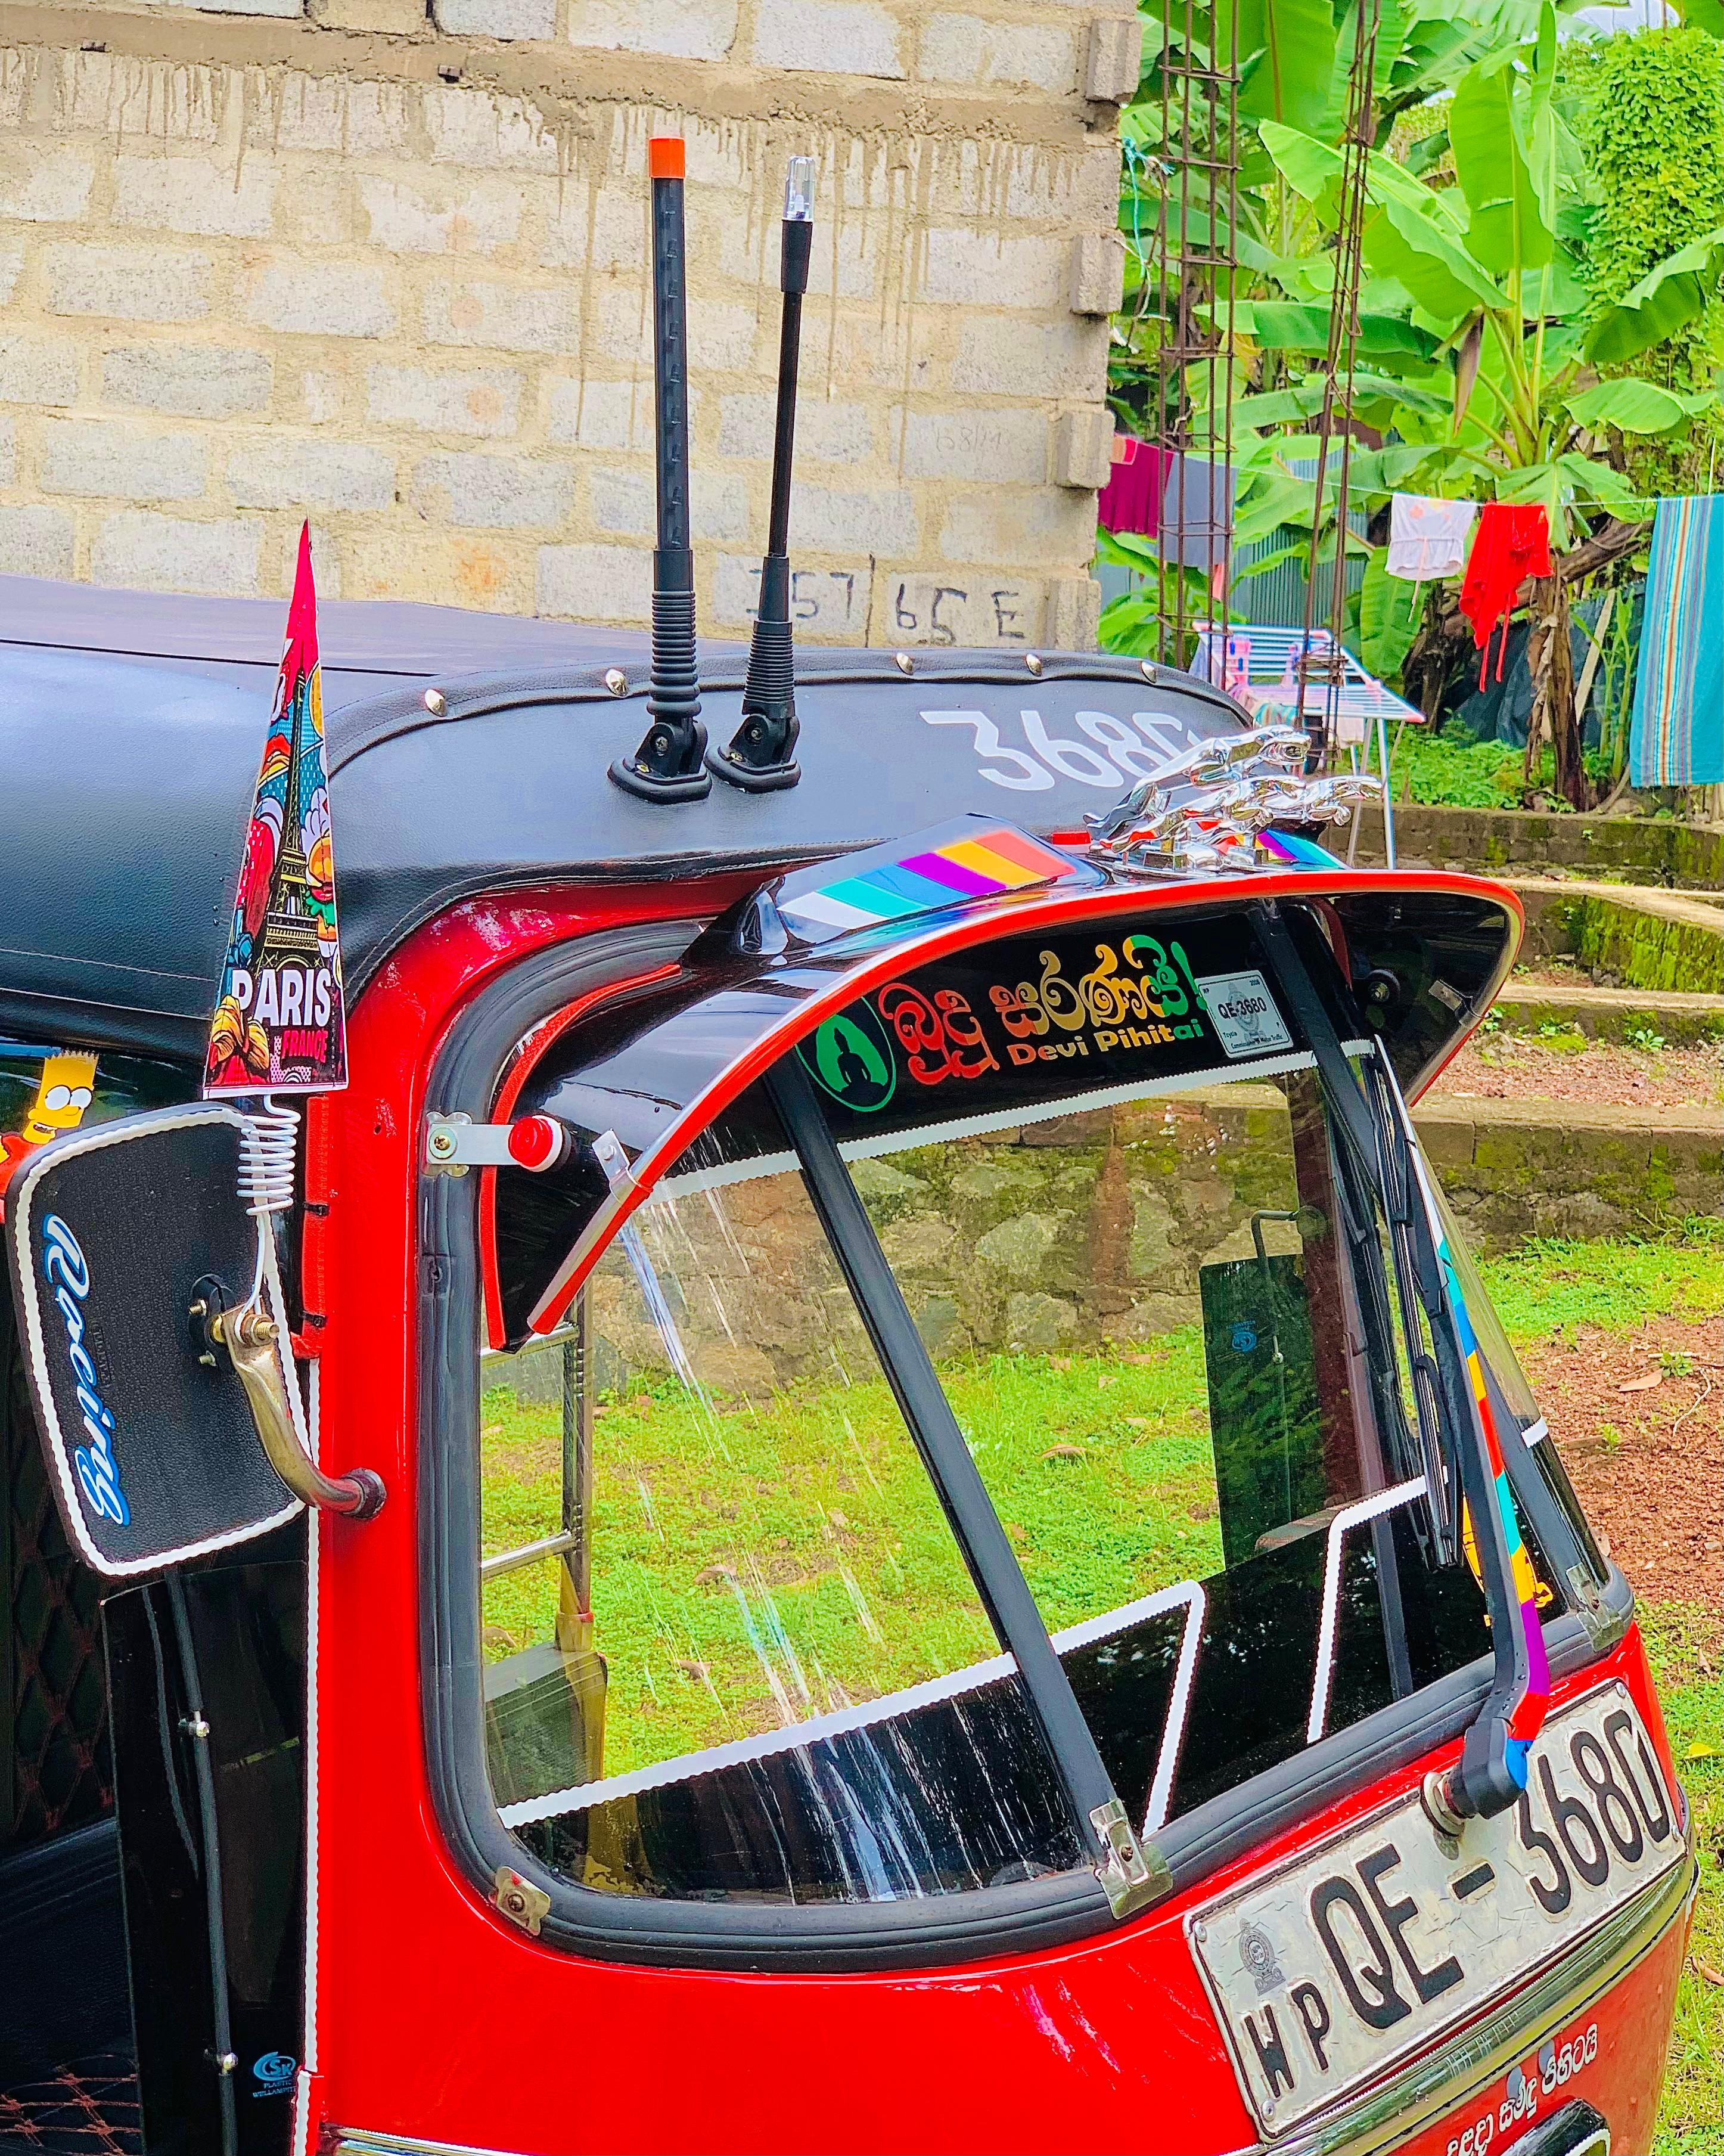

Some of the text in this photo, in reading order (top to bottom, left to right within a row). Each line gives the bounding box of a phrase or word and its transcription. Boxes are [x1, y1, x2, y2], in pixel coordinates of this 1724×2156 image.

[231, 967, 331, 1027] PARIS
[1217, 996, 1268, 1019] QE-3680
[281, 1029, 328, 1063] FRANCE
[879, 982, 1000, 1085] බුදු
[1007, 1019, 1204, 1066] Devi Pihitai
[43, 1212, 131, 1526] Racing
[1244, 1981, 1330, 2098] WP
